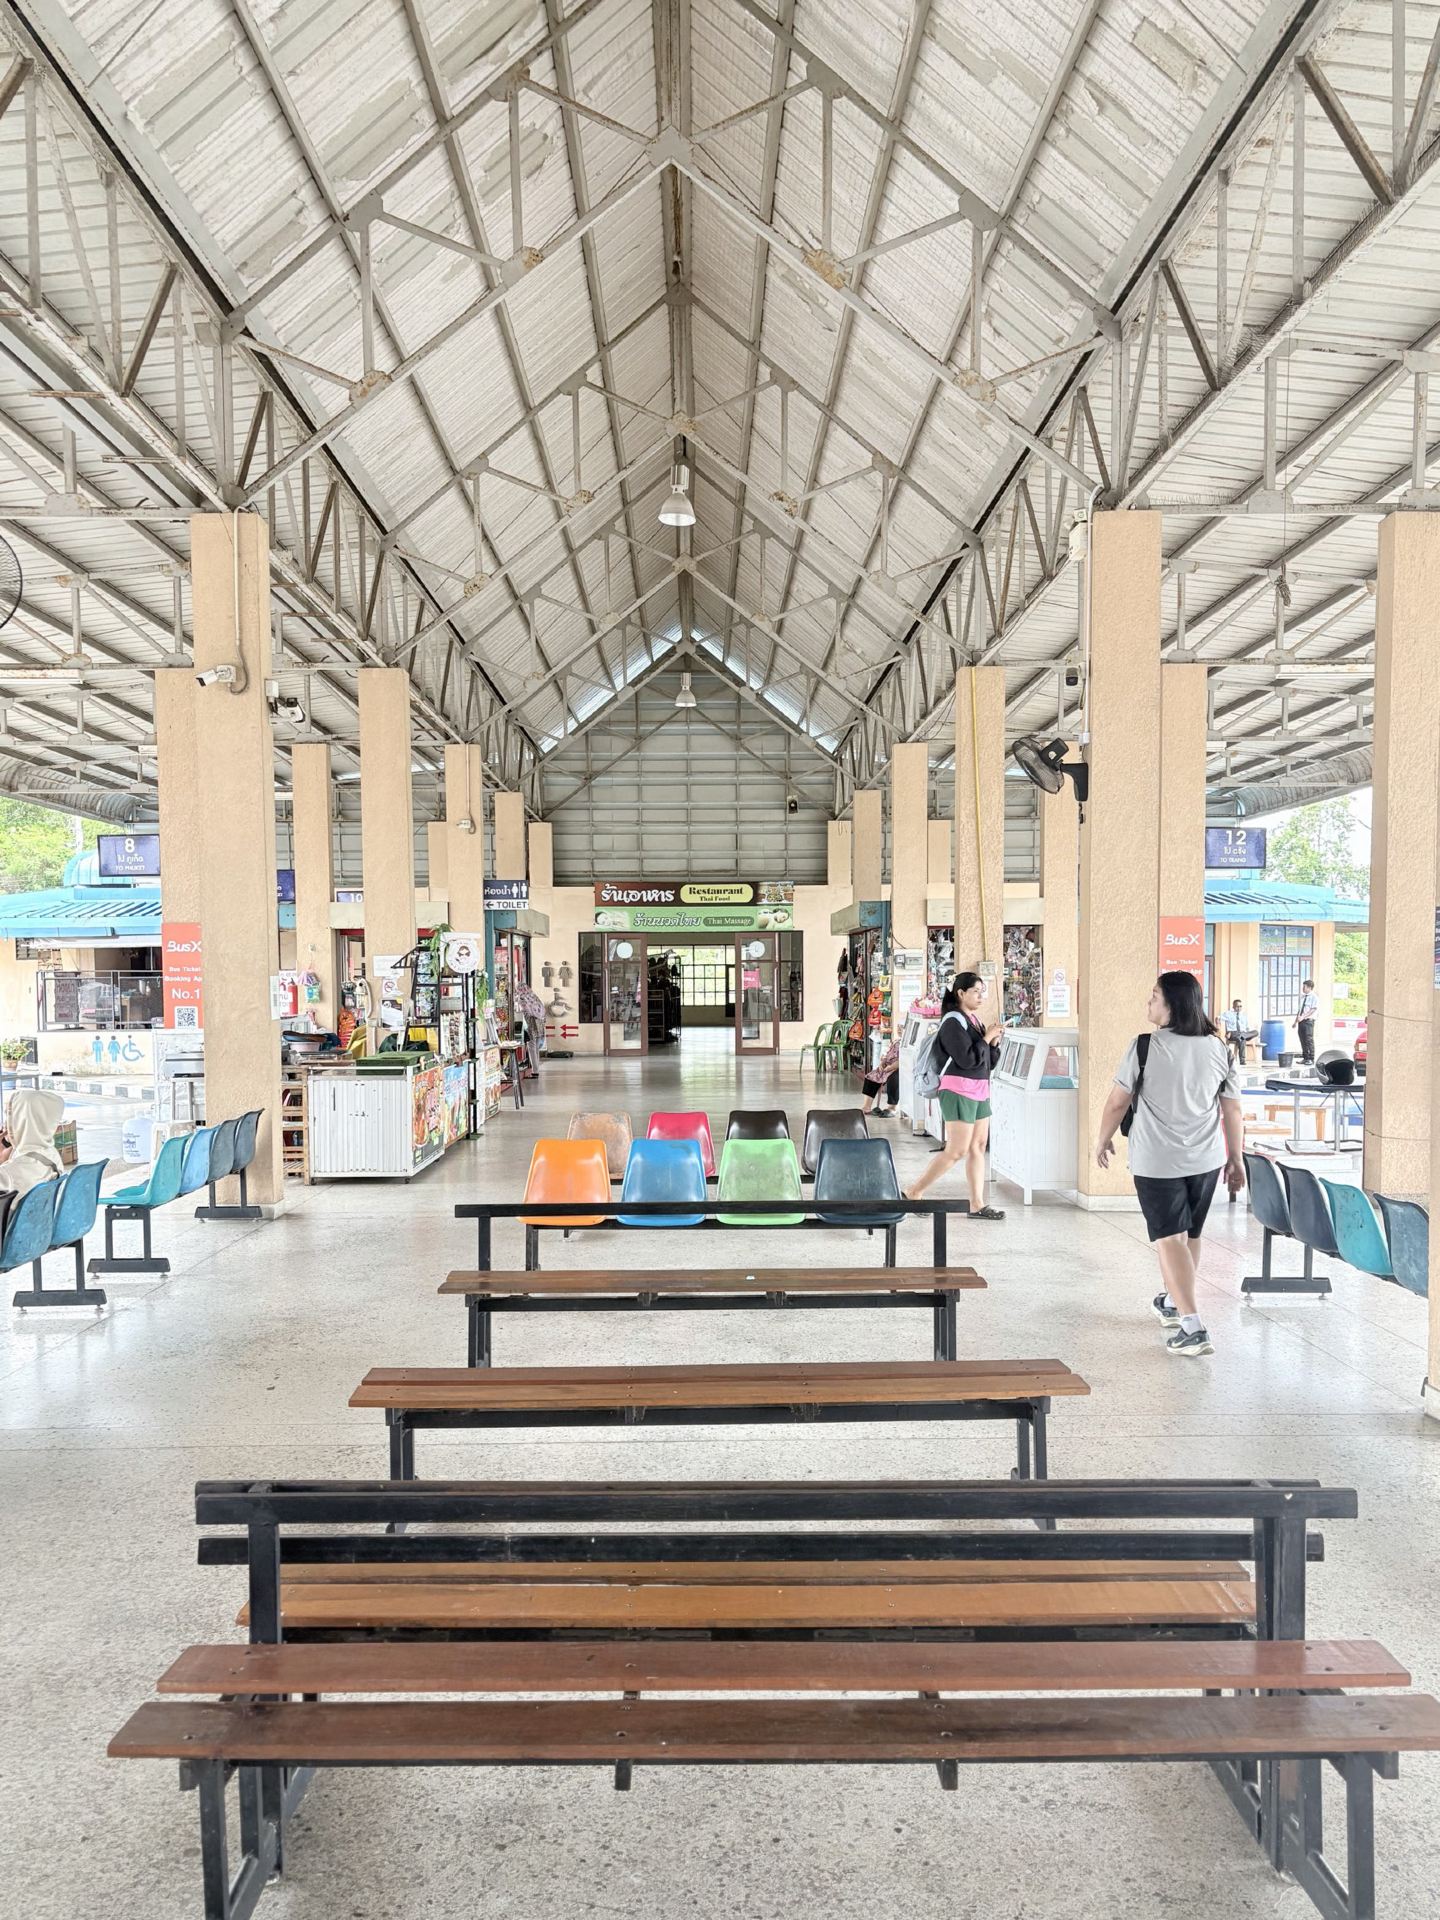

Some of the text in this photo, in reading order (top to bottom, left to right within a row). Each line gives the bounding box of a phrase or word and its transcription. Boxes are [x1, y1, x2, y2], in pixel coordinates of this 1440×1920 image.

[1226, 830, 1247, 846] 12
[124, 837, 135, 853] 8
[484, 884, 511, 896] ห้องน้ำ
[601, 883, 676, 904] ร้านอาหาร
[688, 887, 743, 895] Restaurant
[350, 893, 363, 903] 10
[496, 901, 528, 909] TOILET
[633, 912, 702, 927] ร้านนวดไทย
[708, 917, 753, 926] Thai Massage
[1164, 933, 1200, 945] BusX
[166, 941, 202, 953] BusX
[171, 988, 200, 1000] No.1
